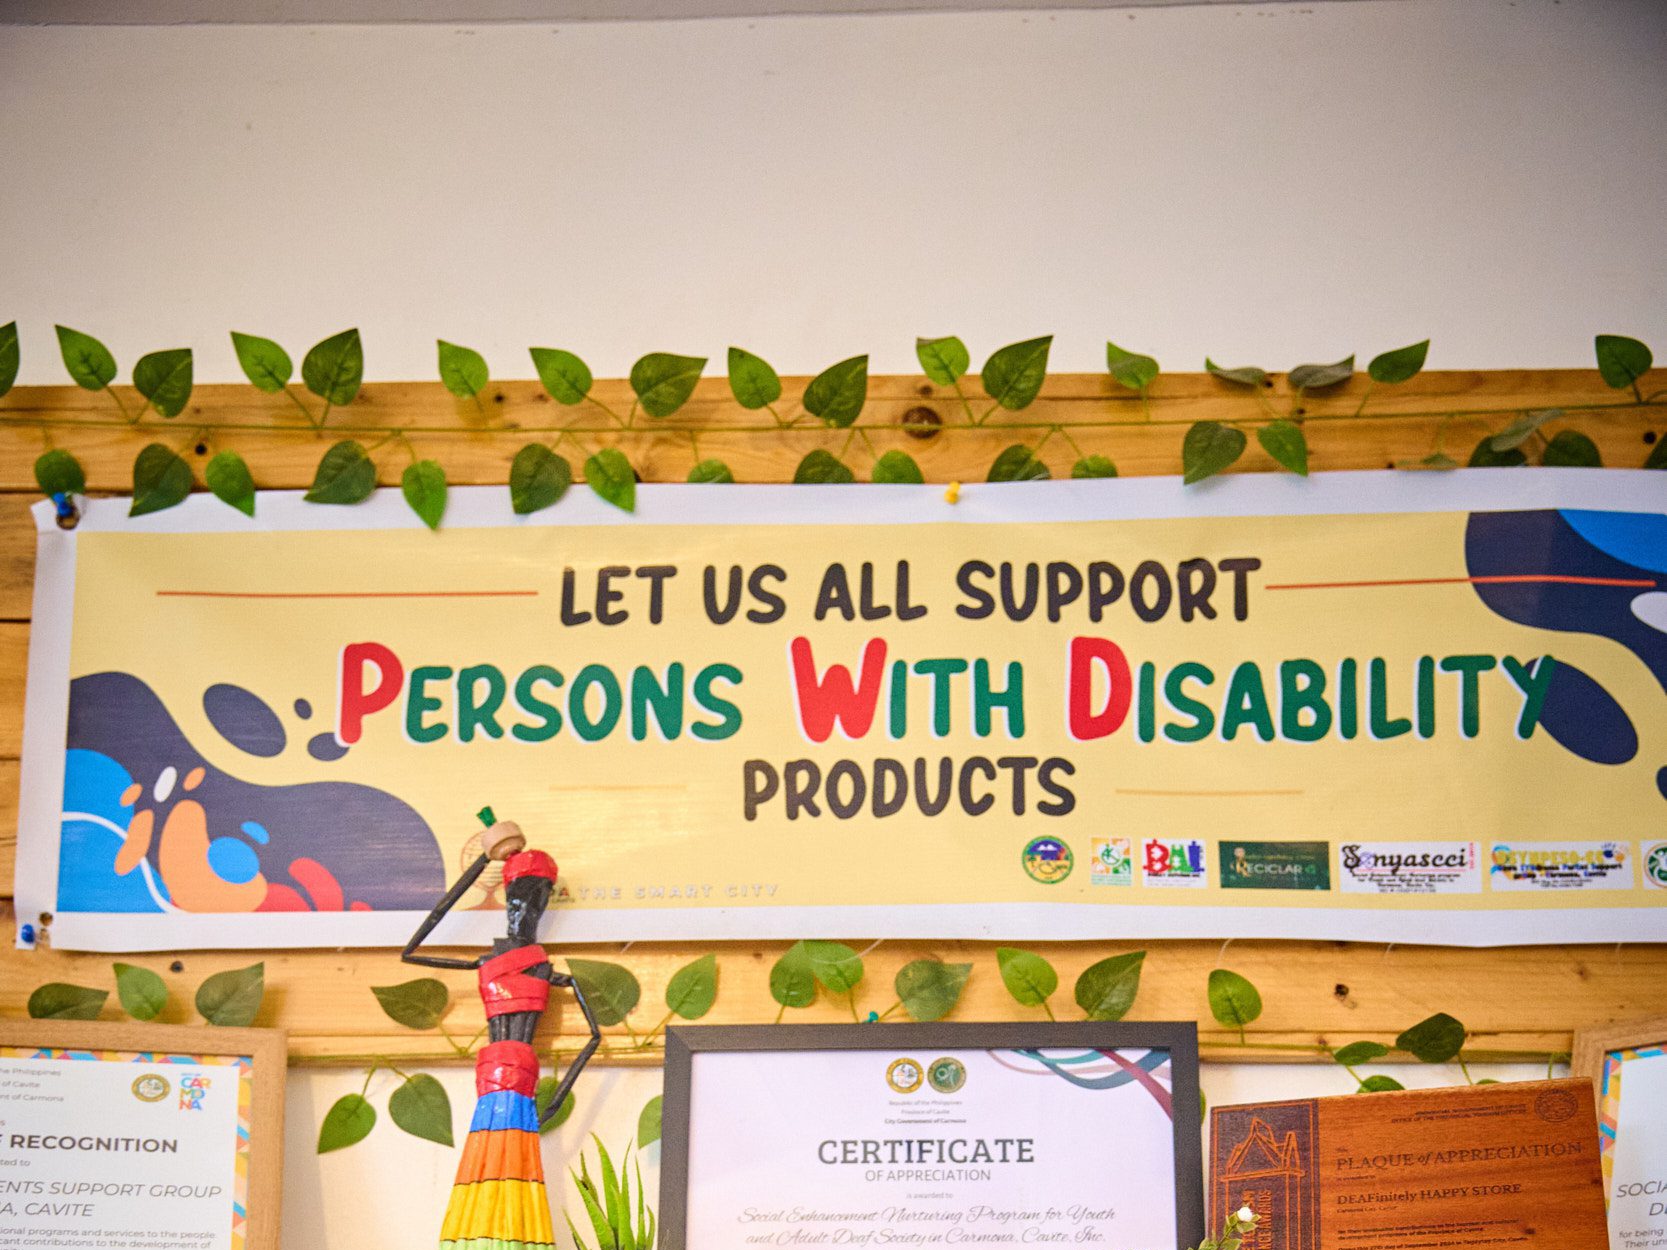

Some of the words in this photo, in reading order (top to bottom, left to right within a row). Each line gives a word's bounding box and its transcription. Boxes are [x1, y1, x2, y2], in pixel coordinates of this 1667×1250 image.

[561, 563, 677, 625] LET
[703, 563, 787, 624] US
[812, 560, 928, 620] ALL
[956, 556, 1261, 622] SUPPORT
[336, 641, 743, 746] PERSONS
[789, 637, 1026, 744] WITH
[1066, 635, 1556, 744] DISABILITY
[743, 756, 1077, 821] PRODUCTS
[579, 887, 622, 900] THE
[634, 885, 713, 899] SMART
[725, 884, 780, 898] CITY
[23, 1094, 64, 1102] Carmona
[10, 1134, 178, 1153] RECOGNITION
[817, 1137, 1035, 1165] CERTIFICATE
[20, 1159, 31, 1167] to
[1337, 1153, 1414, 1170] PLAQUE
[1417, 1151, 1433, 1167] of
[1434, 1141, 1583, 1164] APPRECIATION
[864, 1169, 884, 1182] OF
[886, 1169, 991, 1182] APPRECIATION
[48, 1183, 146, 1197] SUPPORT
[149, 1184, 222, 1198] GROUP
[1420, 1186, 1471, 1201] HAPPY
[1472, 1184, 1523, 1196] STORE
[24, 1202, 95, 1217] CAVITE
[736, 1207, 784, 1224] Social
[785, 1207, 879, 1223] Enhancement
[881, 1207, 962, 1223] Nurturing
[965, 1204, 1041, 1223] Program
[1043, 1206, 1062, 1223] for
[1065, 1204, 1117, 1223] Youth
[28, 1228, 79, 1239] programs
[81, 1229, 102, 1237] and
[104, 1230, 146, 1239] services
[160, 1231, 178, 1239] the
[745, 1230, 773, 1245] and
[774, 1228, 829, 1247] Adult
[830, 1229, 873, 1246] Deaf
[873, 1228, 927, 1246] Society
[1635, 1229, 1664, 1239] being
[23, 1237, 94, 1247] contributions
[96, 1239, 107, 1247] to
[109, 1239, 127, 1247] the
[129, 1239, 198, 1250] development
[200, 1241, 212, 1249] of
